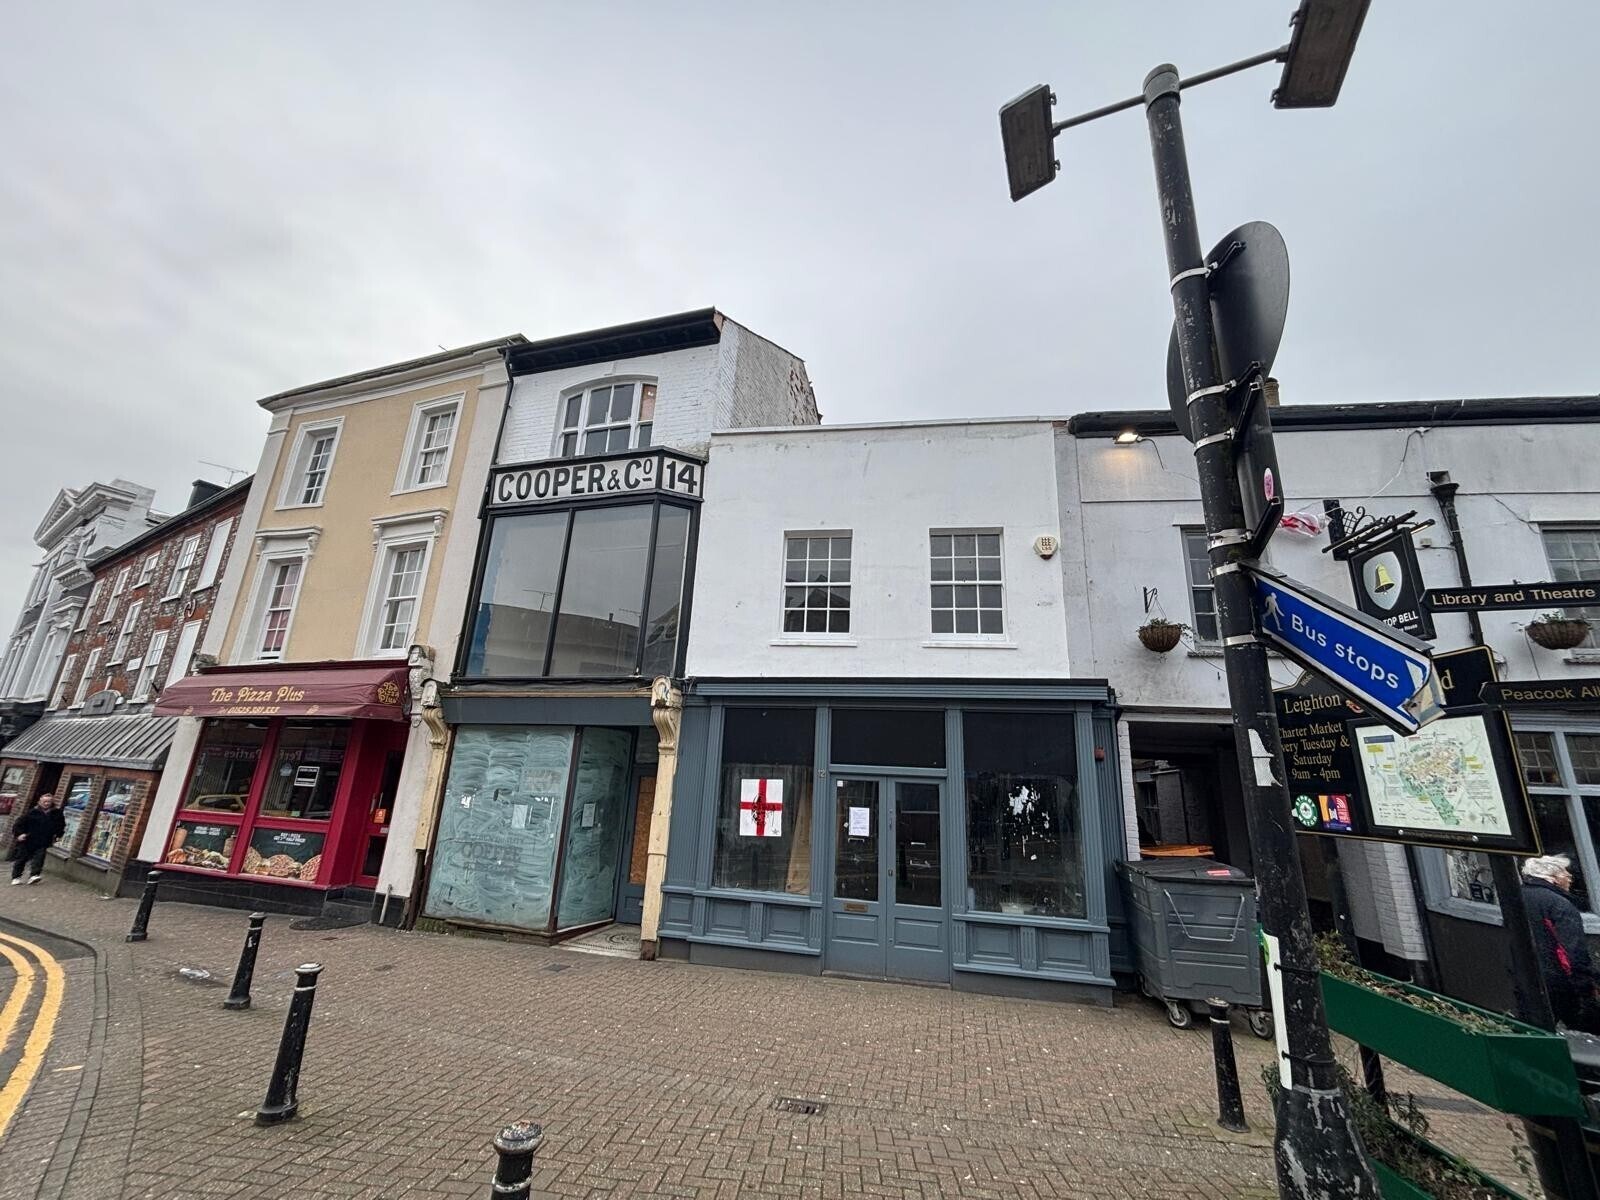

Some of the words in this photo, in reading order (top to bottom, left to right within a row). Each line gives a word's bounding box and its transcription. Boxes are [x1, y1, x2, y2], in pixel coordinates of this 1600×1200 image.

[666, 460, 698, 494] 14
[1432, 593, 1487, 606] Library
[1494, 590, 1525, 602] and
[1529, 587, 1596, 600] Theatre
[1398, 610, 1419, 623] BELL
[1291, 613, 1327, 647] Bus
[1334, 642, 1400, 690] stops
[209, 687, 233, 703] The
[235, 686, 273, 703] Pizza
[275, 686, 305, 703] Plus
[1501, 685, 1574, 700] Peacock
[1283, 693, 1342, 715] Leighton
[1309, 721, 1343, 735] Market
[1281, 741, 1299, 755] very
[1300, 737, 1337, 752] Tuesday
[1339, 734, 1351, 748] &
[1292, 752, 1332, 767] Saturday
[818, 769, 826, 778] 12
[1291, 768, 1311, 780] 9am
[1319, 767, 1341, 782] 4pm
